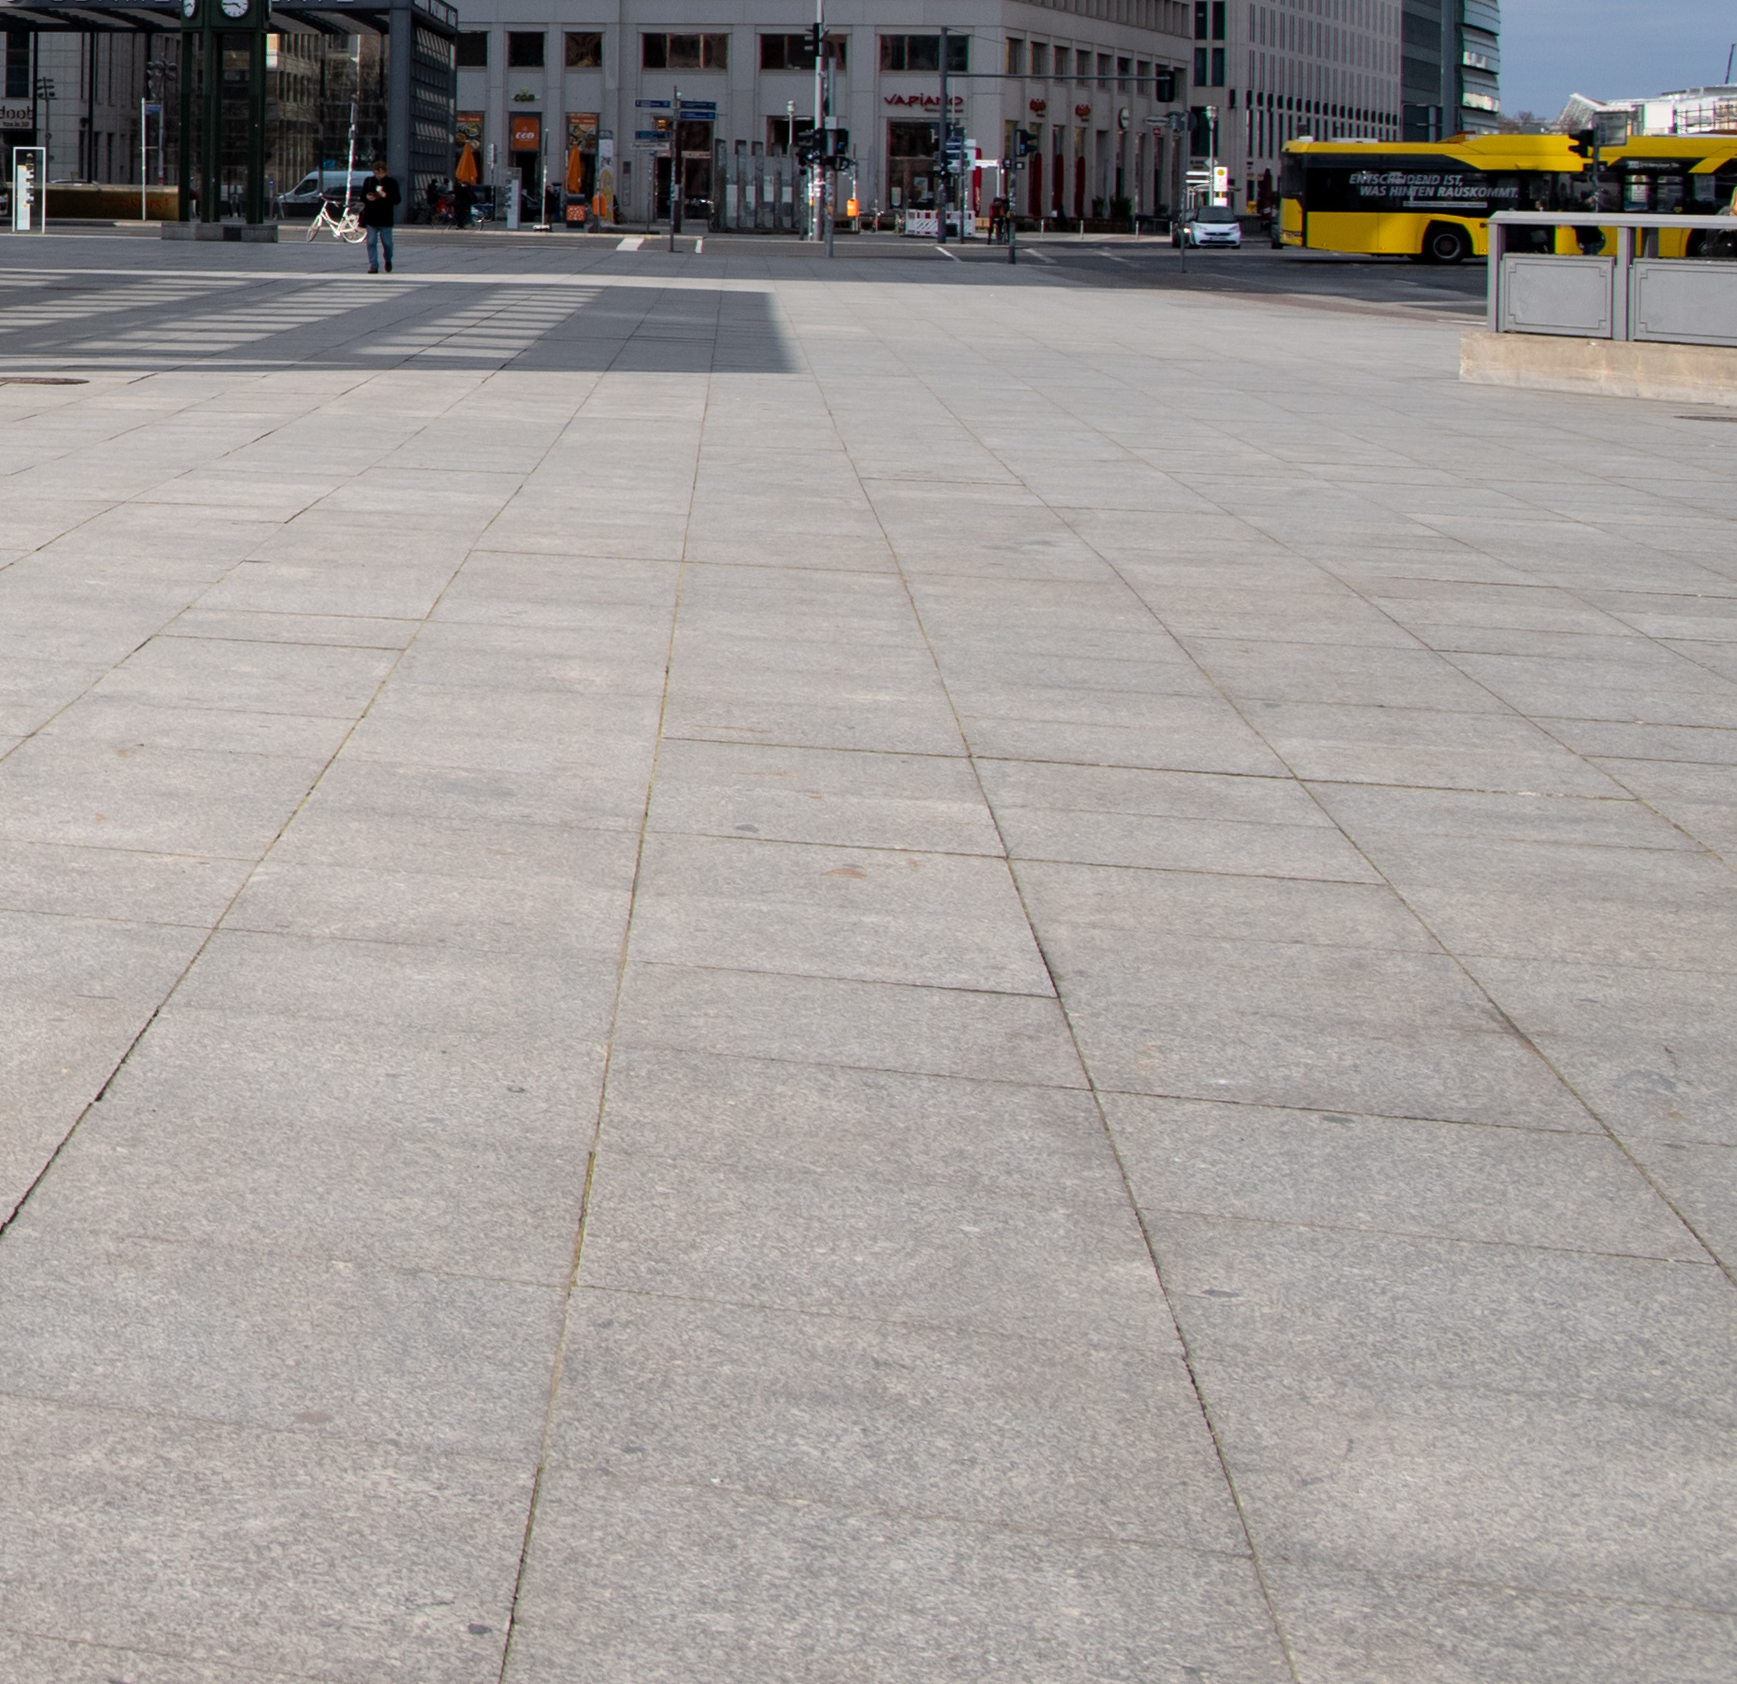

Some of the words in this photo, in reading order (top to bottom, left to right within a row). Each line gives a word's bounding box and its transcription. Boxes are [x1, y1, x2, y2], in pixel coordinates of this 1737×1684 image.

[884, 93, 963, 106] VAPIAO
[1443, 174, 1464, 186] IST,
[1359, 186, 1387, 196] WAS
[1389, 186, 1435, 197] HINTEN
[1437, 187, 1519, 198] RAUSKOMMT.
